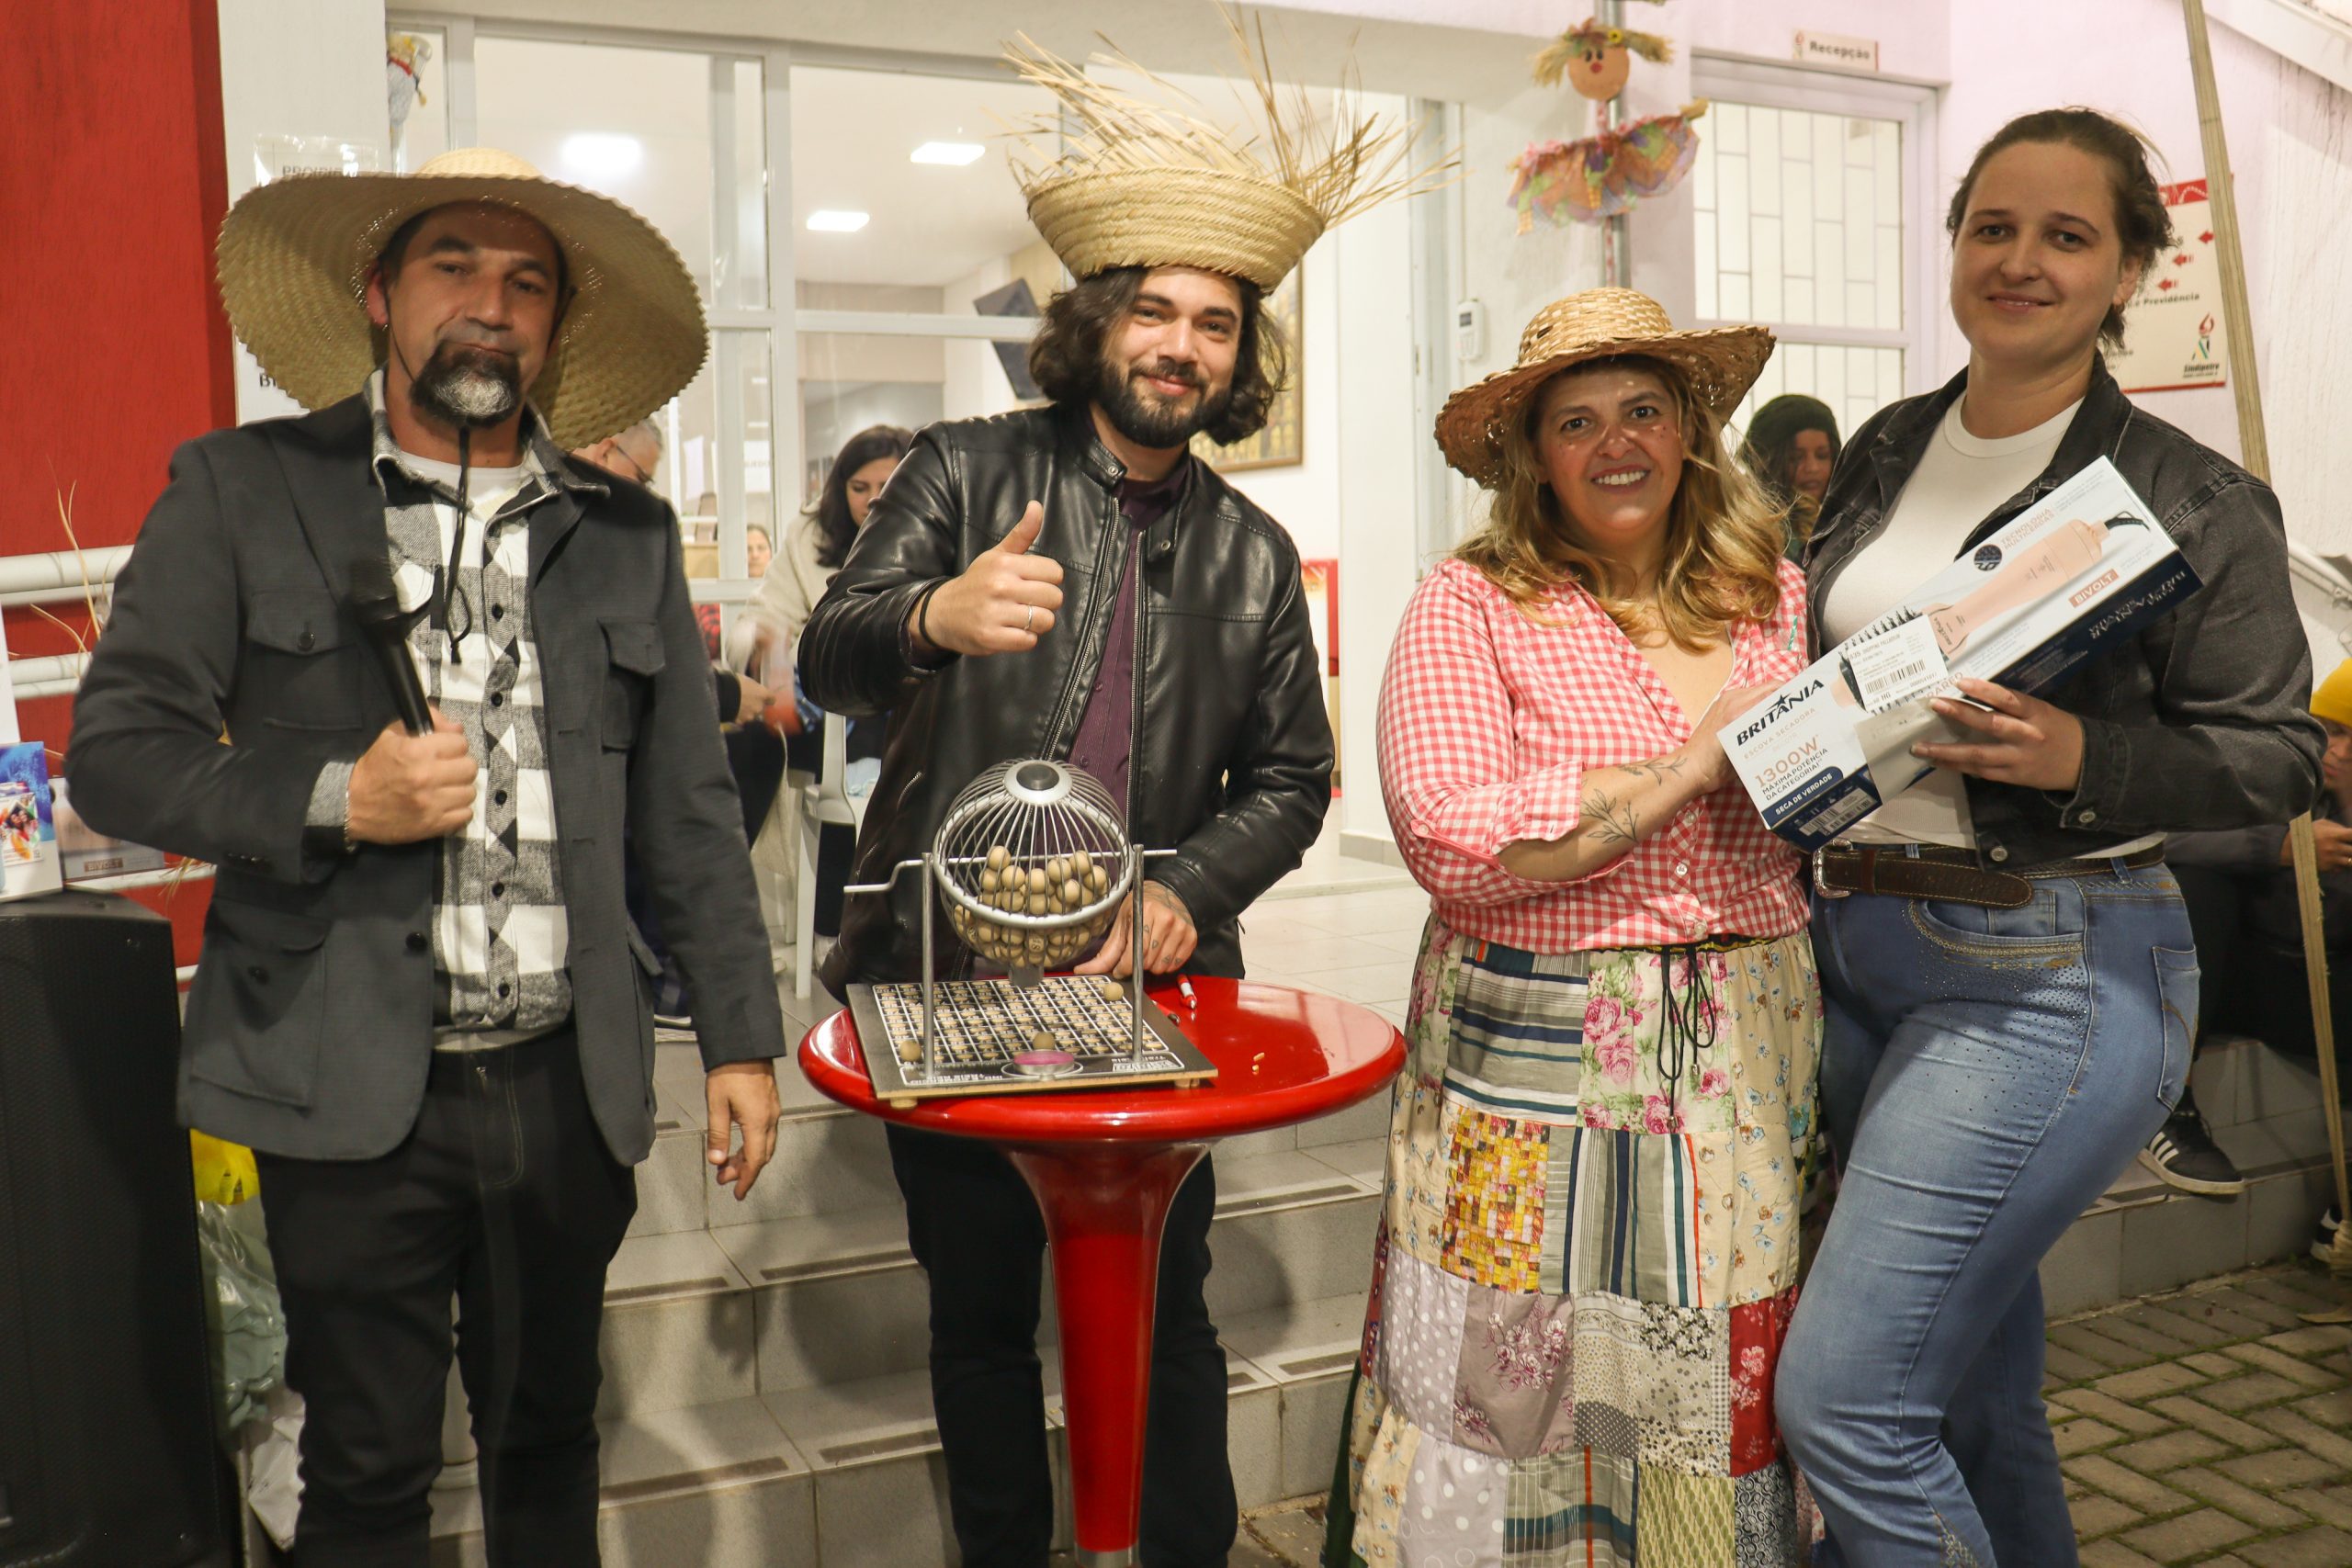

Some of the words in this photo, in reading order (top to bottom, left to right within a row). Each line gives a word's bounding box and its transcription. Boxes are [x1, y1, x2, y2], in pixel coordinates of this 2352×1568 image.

[1809, 40, 1871, 61] Recepção
[2143, 293, 2199, 305] Previdência
[2074, 573, 2113, 604] BIVOLT
[1744, 737, 1774, 759] ESCOVA
[1775, 707, 1815, 737] SECADORA
[1766, 793, 1777, 801] DA
[1775, 800, 1793, 815] SECA
[1793, 793, 1803, 804] DE
[1802, 773, 1833, 797] VERDADE
